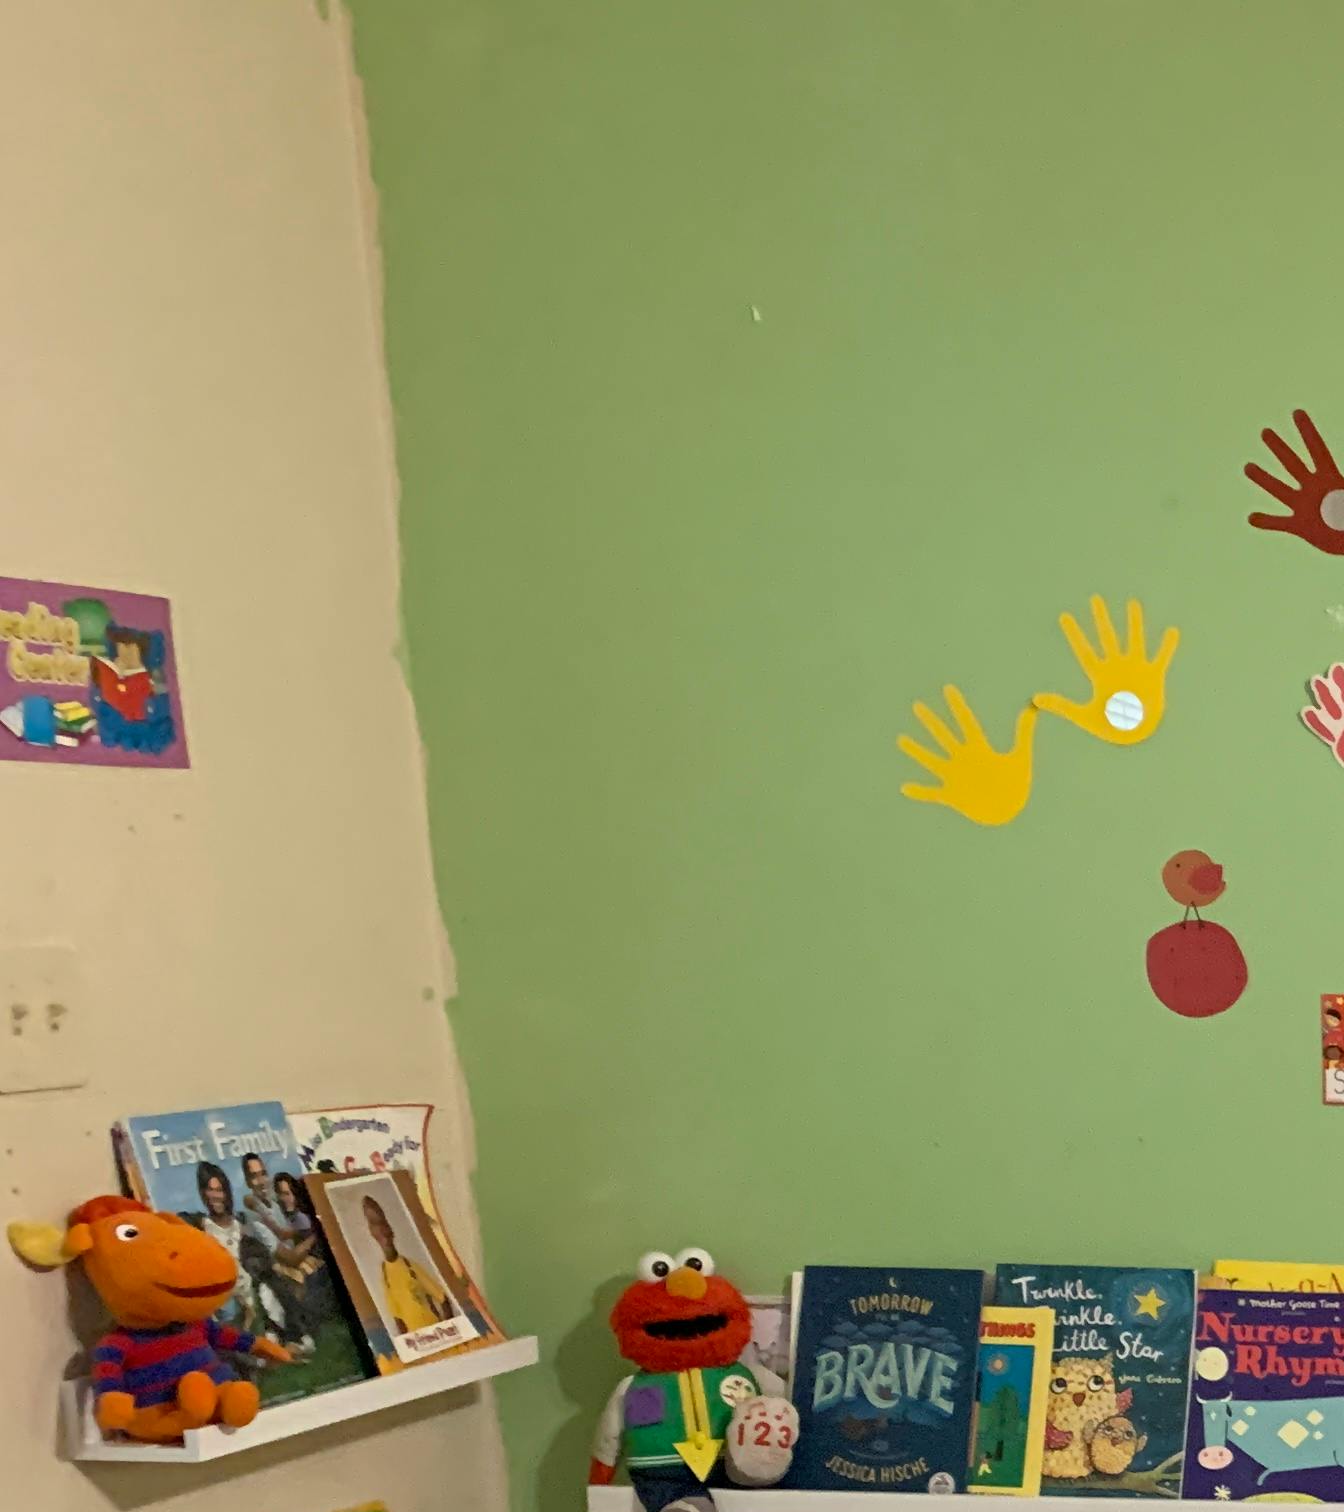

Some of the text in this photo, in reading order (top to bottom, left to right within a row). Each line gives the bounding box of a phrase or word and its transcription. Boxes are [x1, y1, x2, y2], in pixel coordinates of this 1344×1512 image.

[141, 1119, 292, 1170] First Family
[849, 1292, 935, 1317] TOMORROW
[1319, 1299, 1341, 1310] Time
[1115, 1331, 1164, 1363] Star
[812, 1340, 960, 1416] BRAVE
[824, 1454, 931, 1484] JESSICA HISCHE
